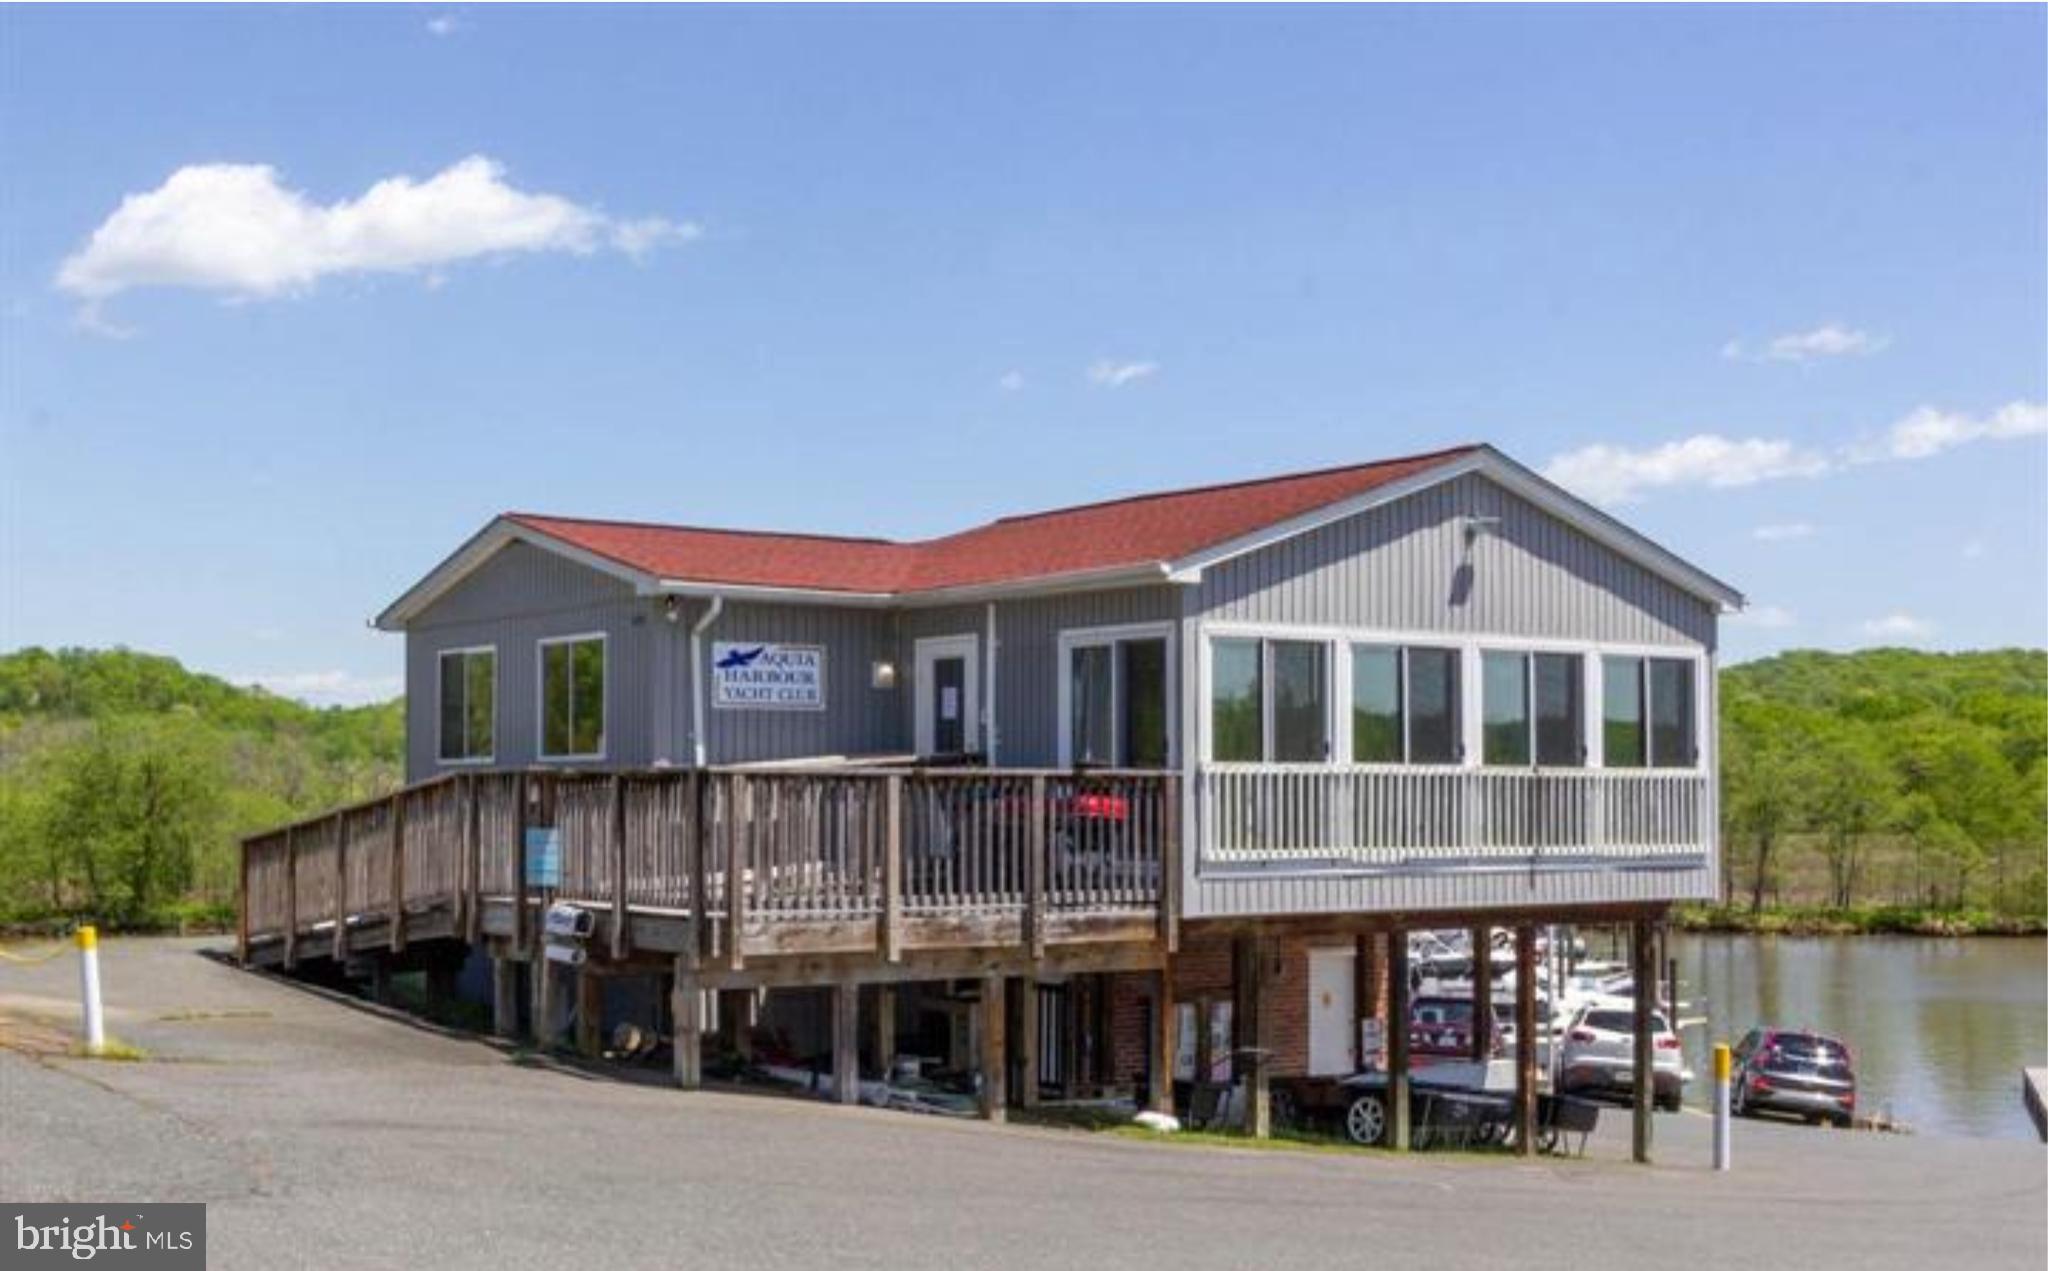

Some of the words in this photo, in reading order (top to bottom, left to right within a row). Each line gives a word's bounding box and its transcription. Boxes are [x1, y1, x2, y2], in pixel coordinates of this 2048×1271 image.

[759, 653, 815, 667] AQUIA
[724, 669, 816, 685] HARBOUR
[726, 687, 772, 700] YACHT
[778, 688, 816, 700] CLUB
